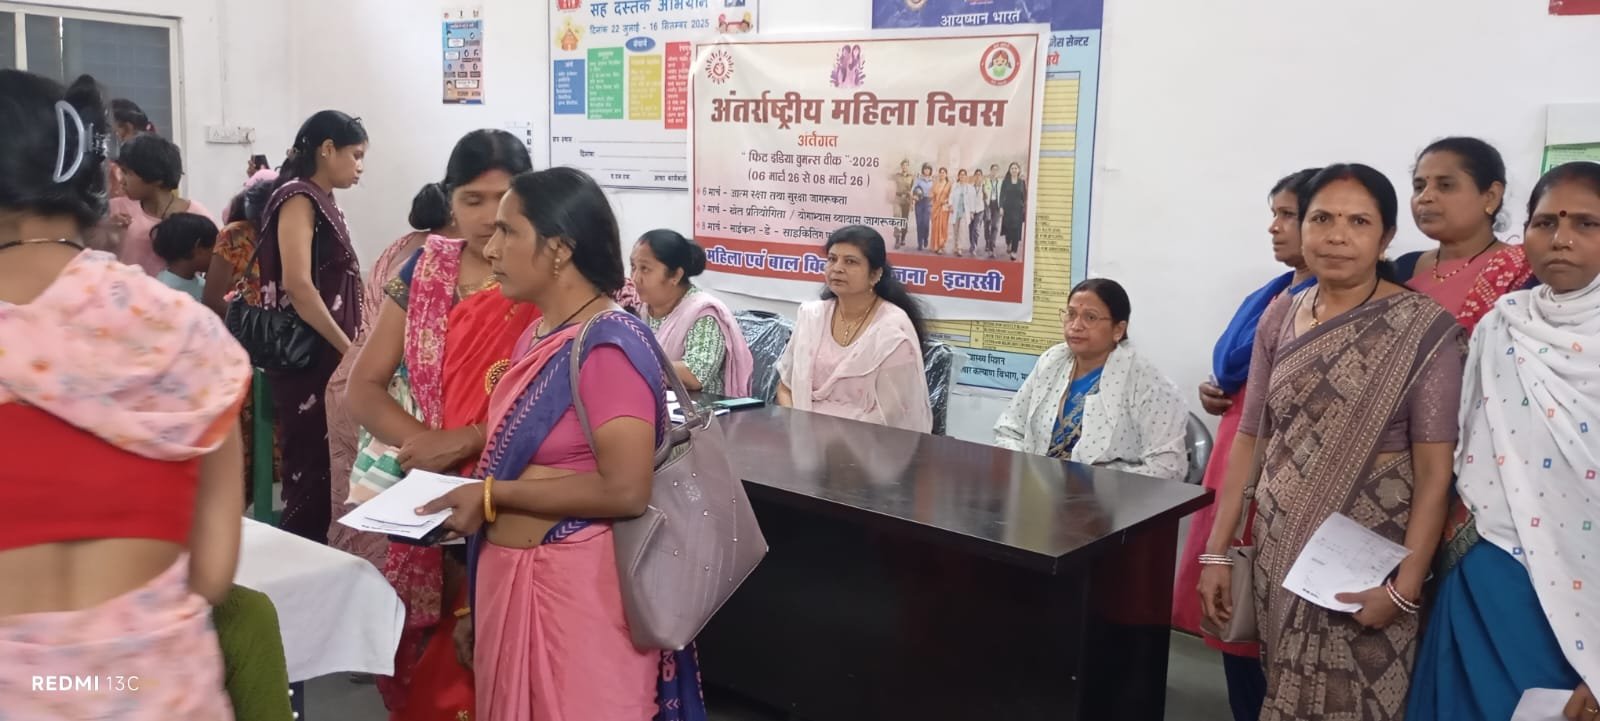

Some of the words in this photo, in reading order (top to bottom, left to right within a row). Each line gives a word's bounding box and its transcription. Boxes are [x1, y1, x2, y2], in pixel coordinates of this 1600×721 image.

[590, 2, 608, 17] सह
[614, 0, 650, 15] दस्तक
[993, 9, 1020, 24] भारत
[611, 24, 620, 33] 22
[650, 22, 658, 31] 16
[691, 19, 709, 29] 2025
[831, 91, 919, 125] महिला
[926, 92, 1008, 127] दिवस
[748, 149, 768, 163] फिट
[823, 152, 842, 166] वीक
[748, 168, 766, 181] (06
[788, 172, 799, 183] 26
[802, 170, 811, 184] से
[813, 174, 825, 185] 08
[751, 189, 767, 200] रक्षा
[769, 191, 785, 201] तथा
[787, 192, 807, 205] सुरक्षा
[810, 194, 848, 206] जागरूकता
[705, 245, 742, 267] महिला
[745, 248, 767, 269] एवं
[768, 255, 801, 272] बाल
[942, 270, 1004, 292] इटारसी
